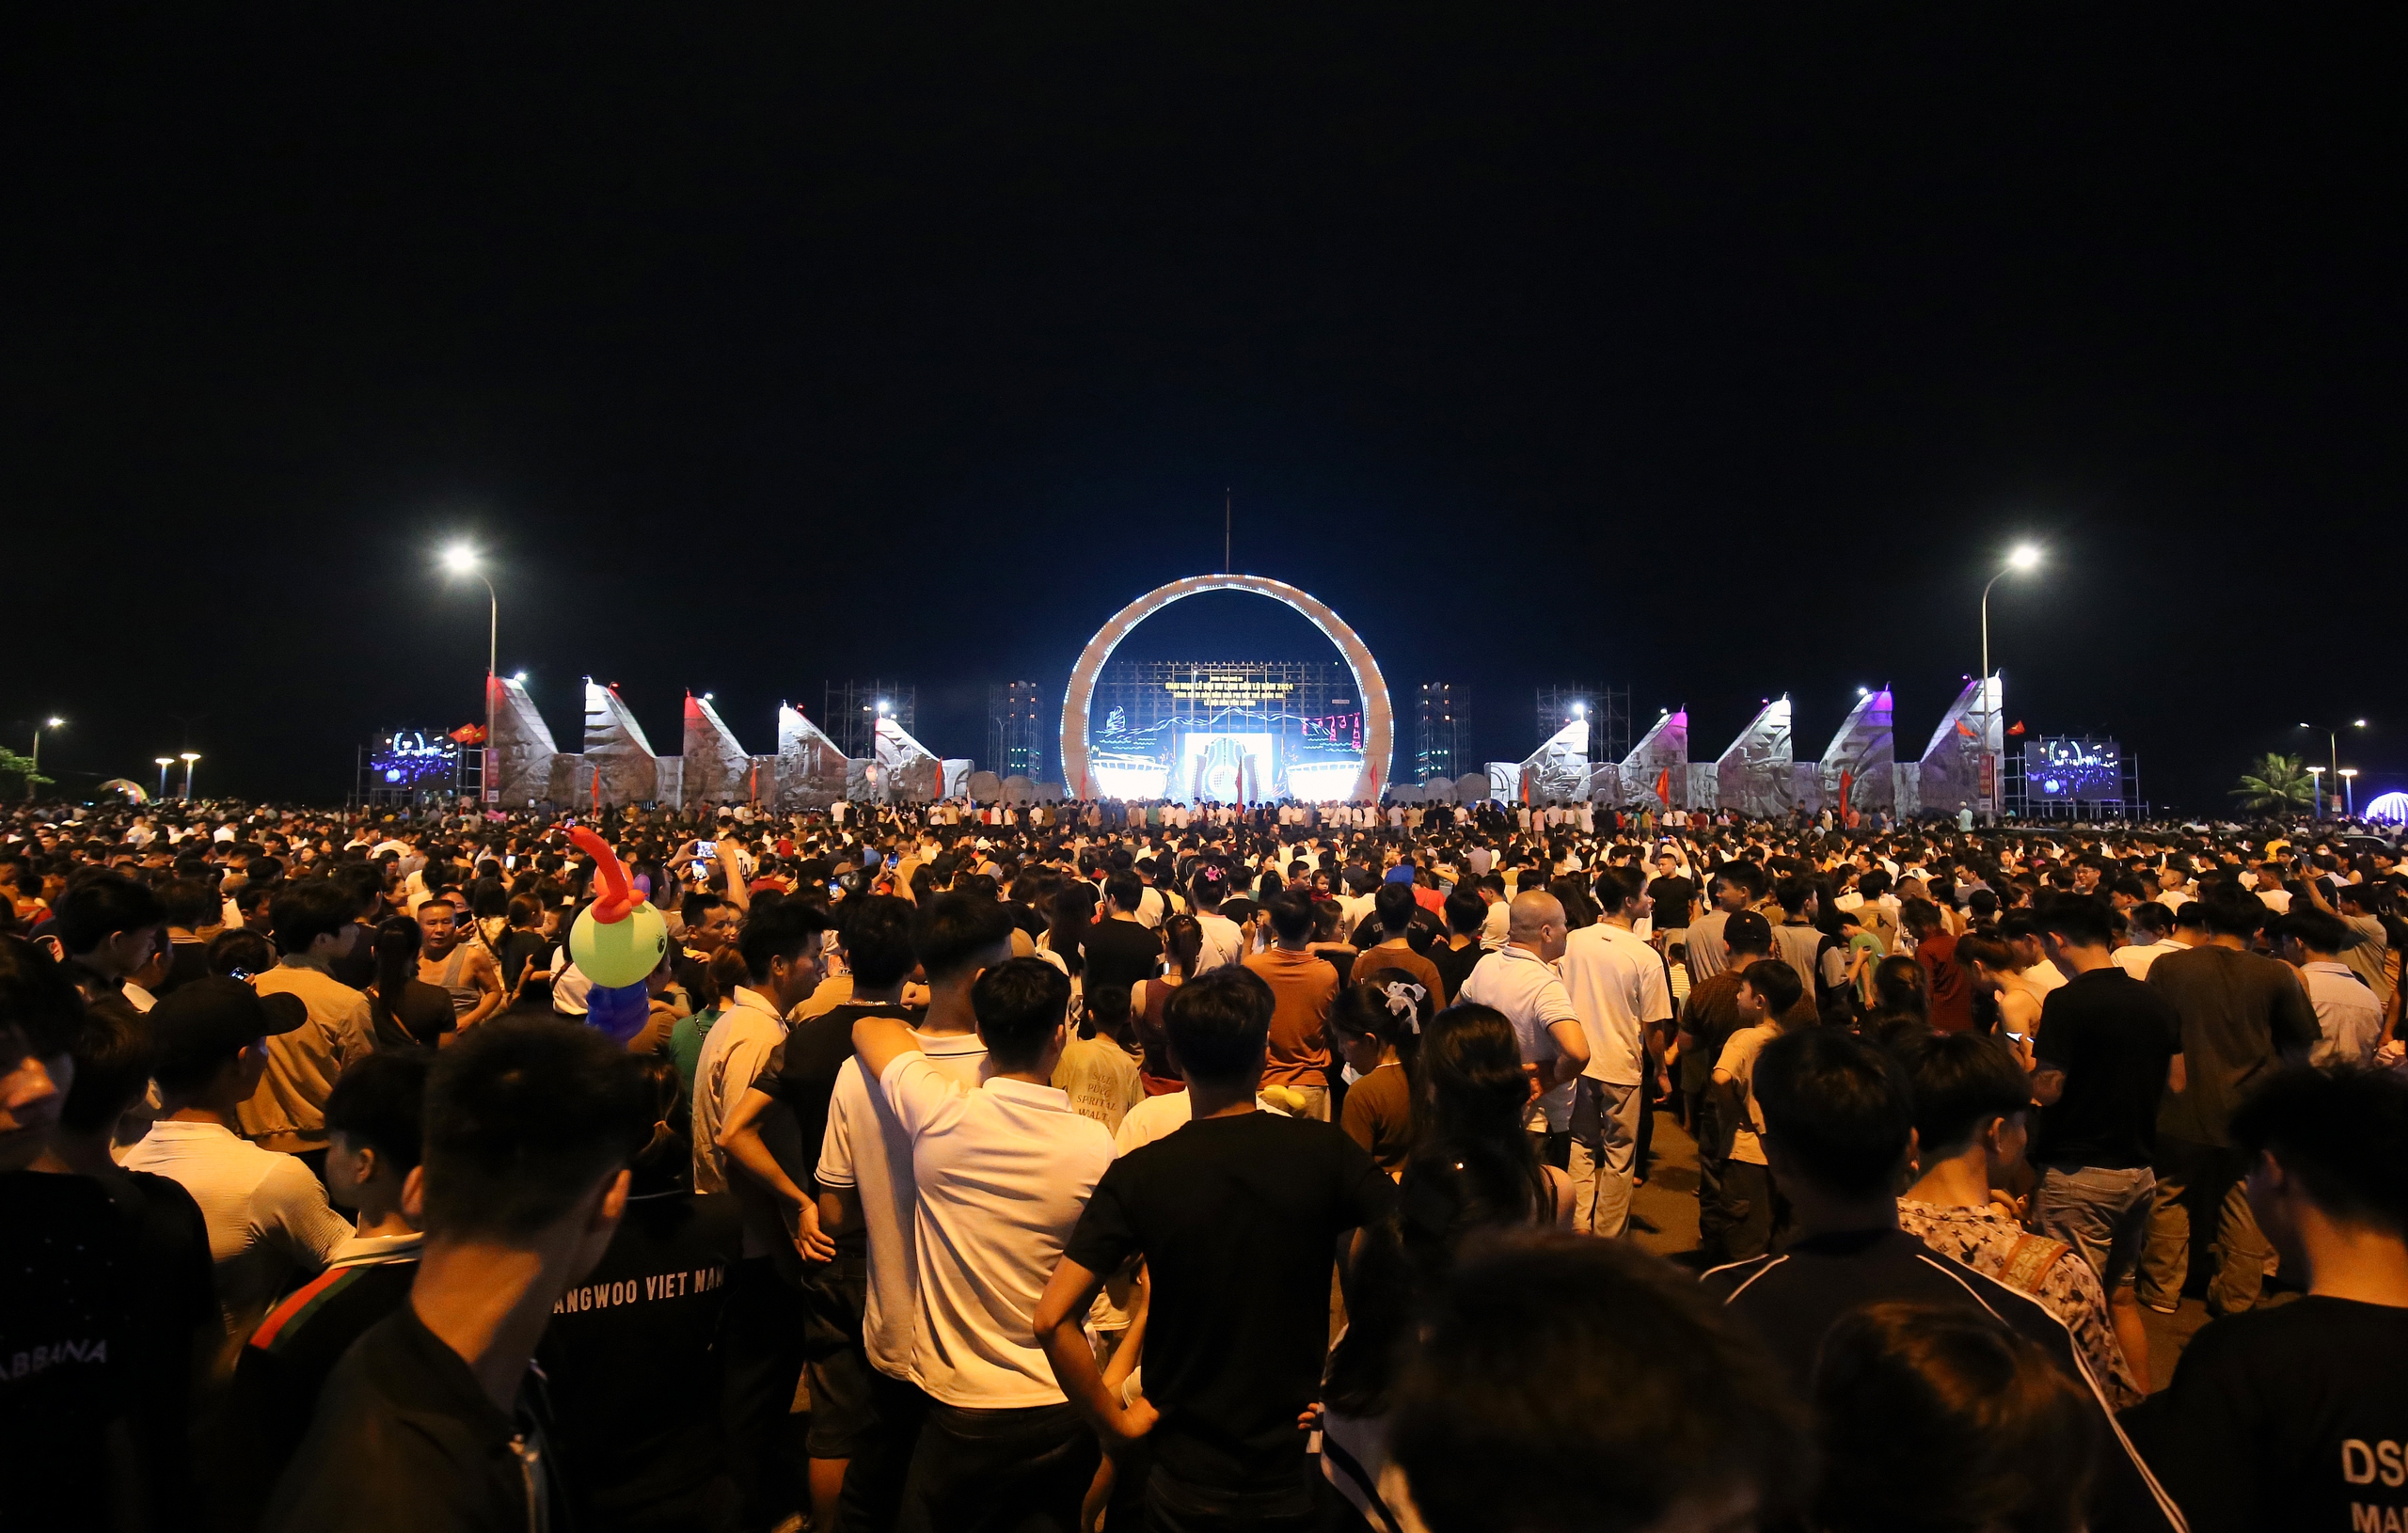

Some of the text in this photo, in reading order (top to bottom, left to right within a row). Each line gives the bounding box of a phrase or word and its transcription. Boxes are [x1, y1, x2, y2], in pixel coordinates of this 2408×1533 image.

[645, 1271, 689, 1302] VIET
[2341, 1438, 2408, 1489] DS
[2350, 1501, 2408, 1533] MA
